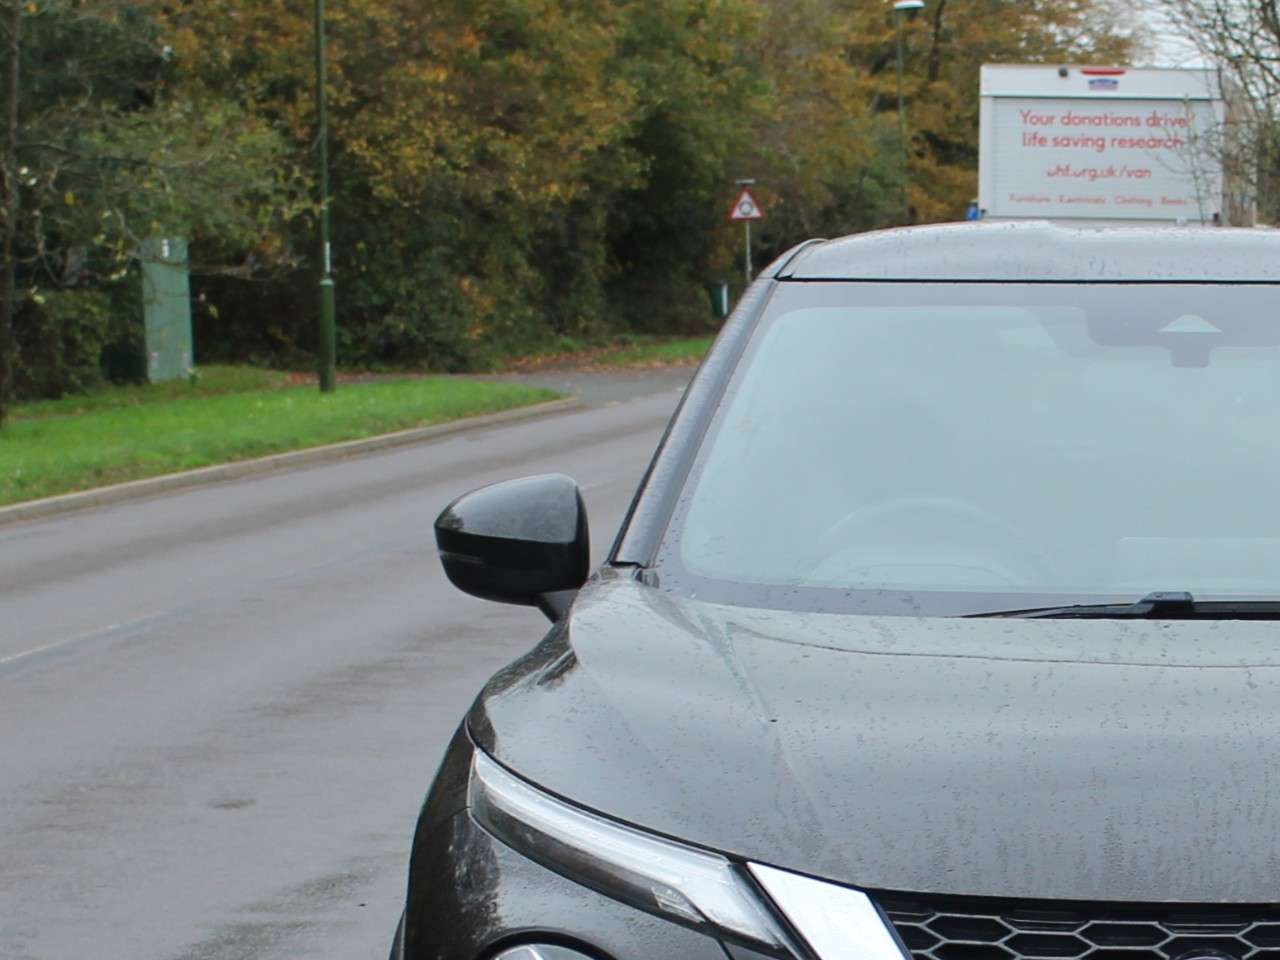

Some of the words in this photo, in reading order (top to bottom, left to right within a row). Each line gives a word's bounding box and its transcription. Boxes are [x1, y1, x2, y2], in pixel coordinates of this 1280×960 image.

[1020, 109, 1055, 126] Your
[1061, 110, 1141, 127] donations
[1146, 110, 1188, 128] drive
[1022, 132, 1047, 147] life
[1052, 133, 1105, 152] saving
[1111, 131, 1184, 150] research
